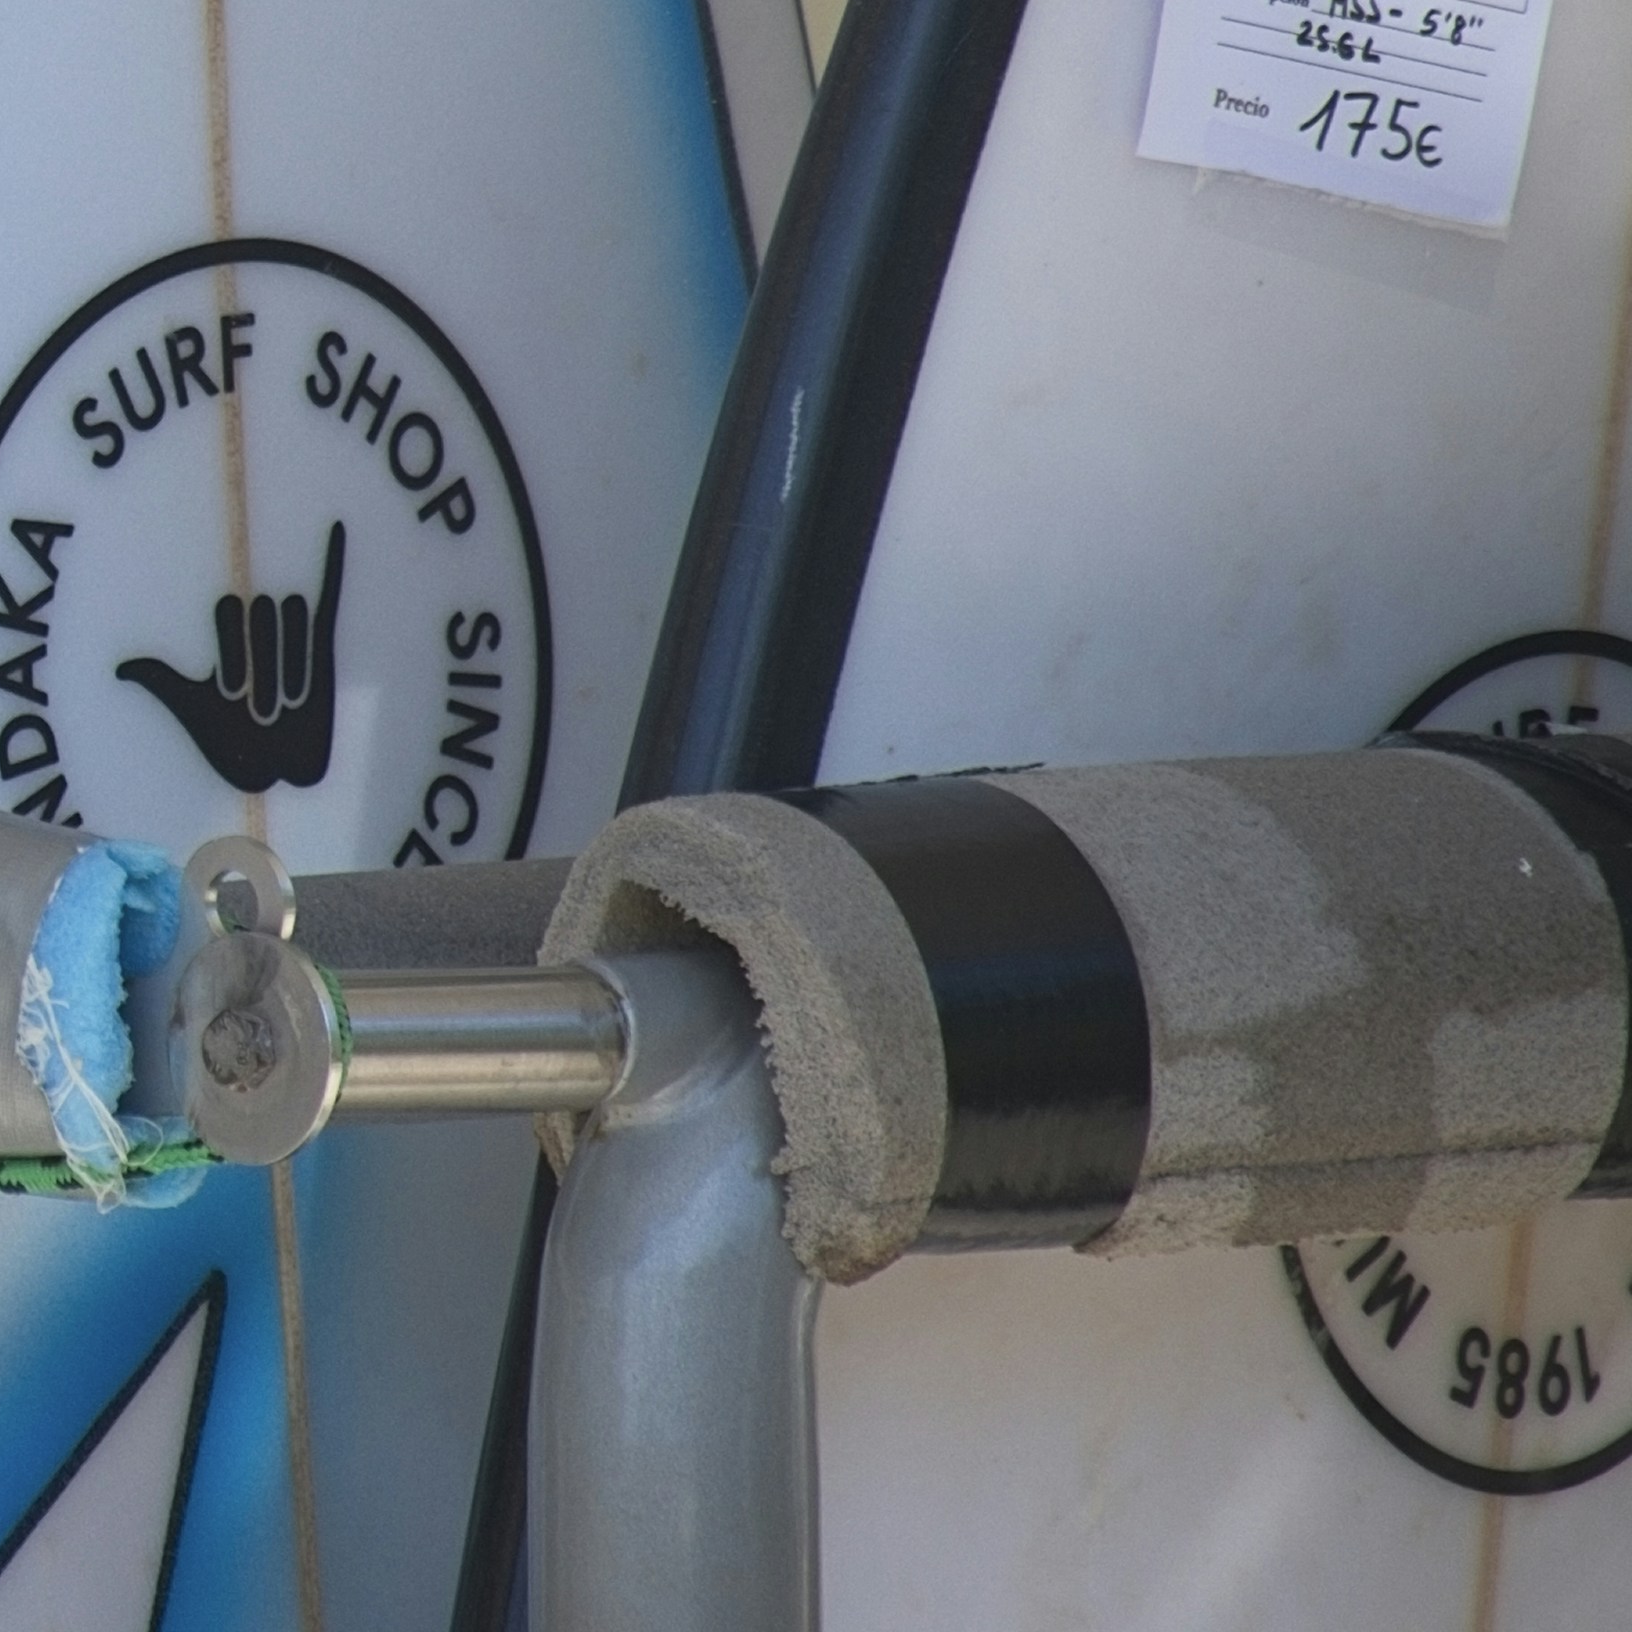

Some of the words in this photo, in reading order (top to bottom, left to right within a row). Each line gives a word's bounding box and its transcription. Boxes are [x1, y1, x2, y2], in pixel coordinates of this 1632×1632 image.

[1212, 87, 1270, 119] Precio
[1298, 88, 1444, 169] 175€
[71, 311, 256, 470] SURF
[305, 330, 477, 536] SHOP
[1448, 1325, 1601, 1420] 1985
